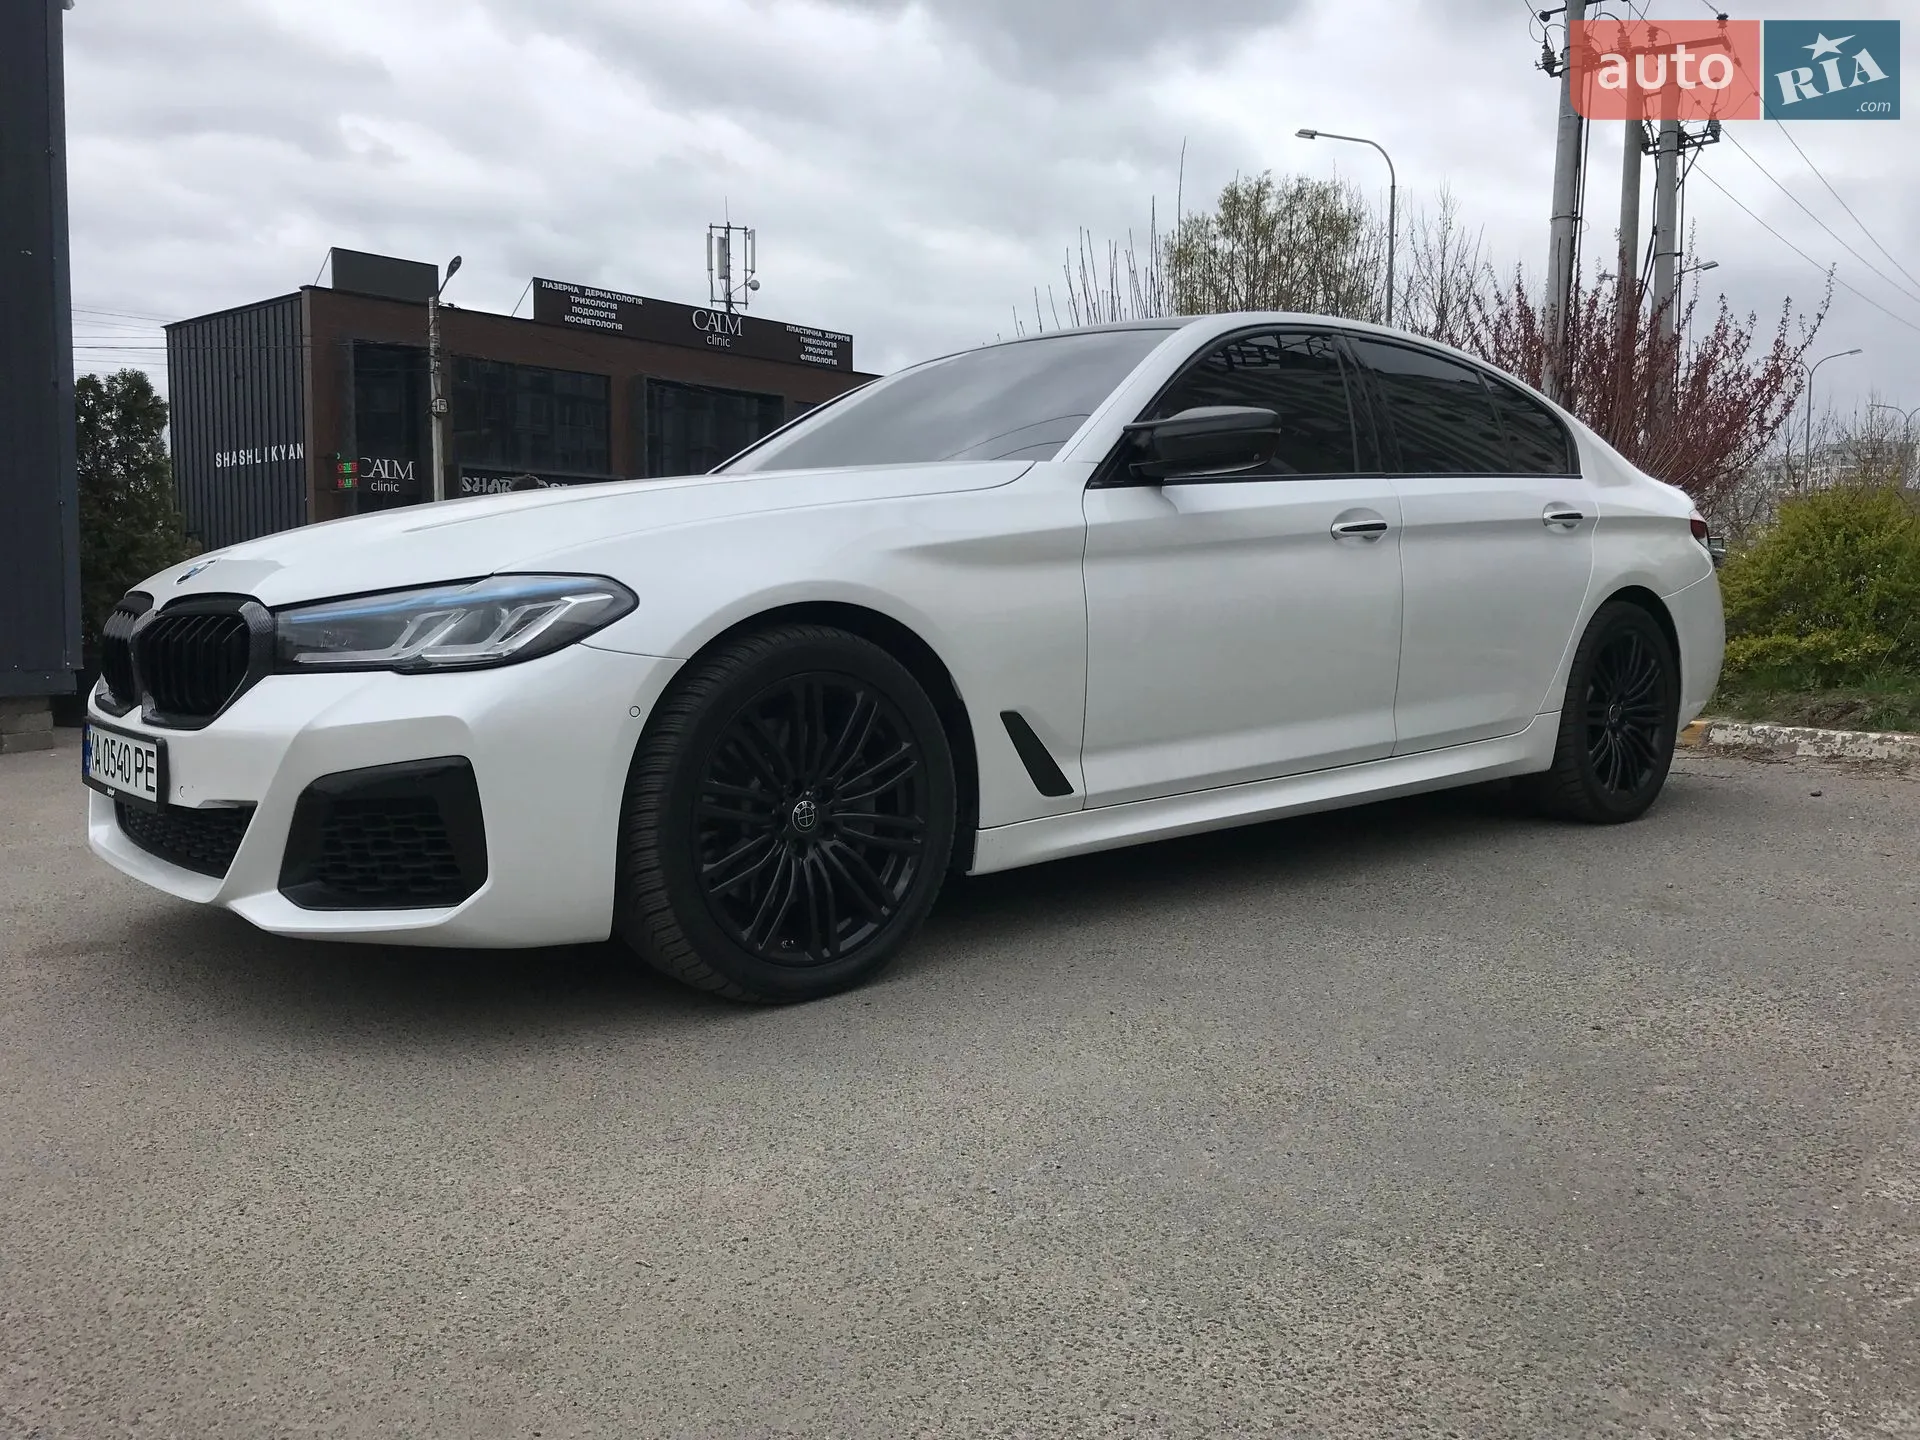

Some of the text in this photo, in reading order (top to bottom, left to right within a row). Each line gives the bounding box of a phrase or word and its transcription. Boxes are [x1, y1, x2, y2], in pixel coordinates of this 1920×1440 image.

[541, 280, 643, 305] ЛАЗЕРНА ДЕРМАТОЛОГІЯ
[570, 295, 618, 310] ТРИХОЛОГІЯ
[571, 306, 616, 320] ПОДОЛОГІЯ
[564, 315, 623, 331] КОСМЕТОЛОГІЯ
[692, 309, 743, 337] CALM
[786, 325, 823, 338] ПЛАСТИЧНА
[706, 334, 731, 348] clinic
[800, 336, 838, 349] ГІНЕКОЛОГІЯ
[804, 345, 834, 356] УРОЛОГІЯ
[800, 354, 838, 366] ФЛЕБОЛОГІЯ
[215, 442, 304, 468] SHASHLIKYAN
[370, 480, 400, 493] clinic
[104, 737, 131, 784] 0540
[135, 746, 156, 793] PE
